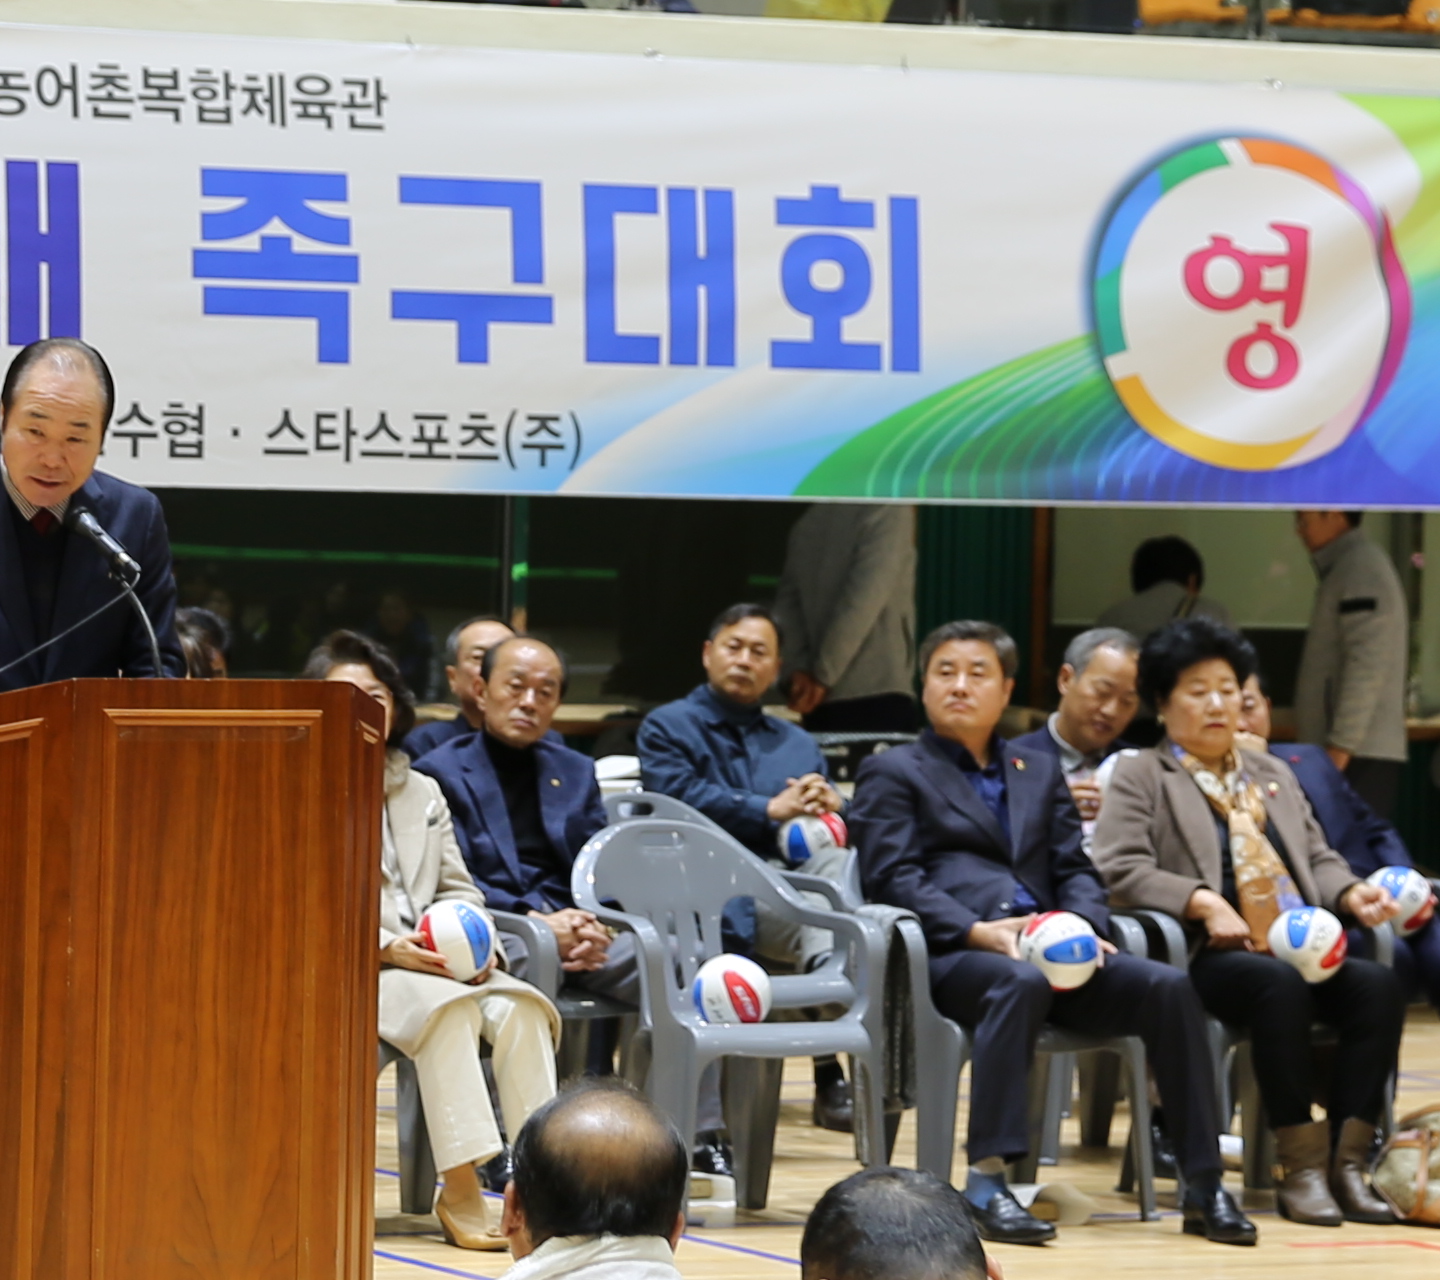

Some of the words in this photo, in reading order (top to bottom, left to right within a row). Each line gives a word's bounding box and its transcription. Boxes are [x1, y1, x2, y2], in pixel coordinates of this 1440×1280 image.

[192, 167, 922, 375] 족구대회
[1183, 223, 1310, 390] 영
[262, 408, 583, 471] 스타스포츠(주)
